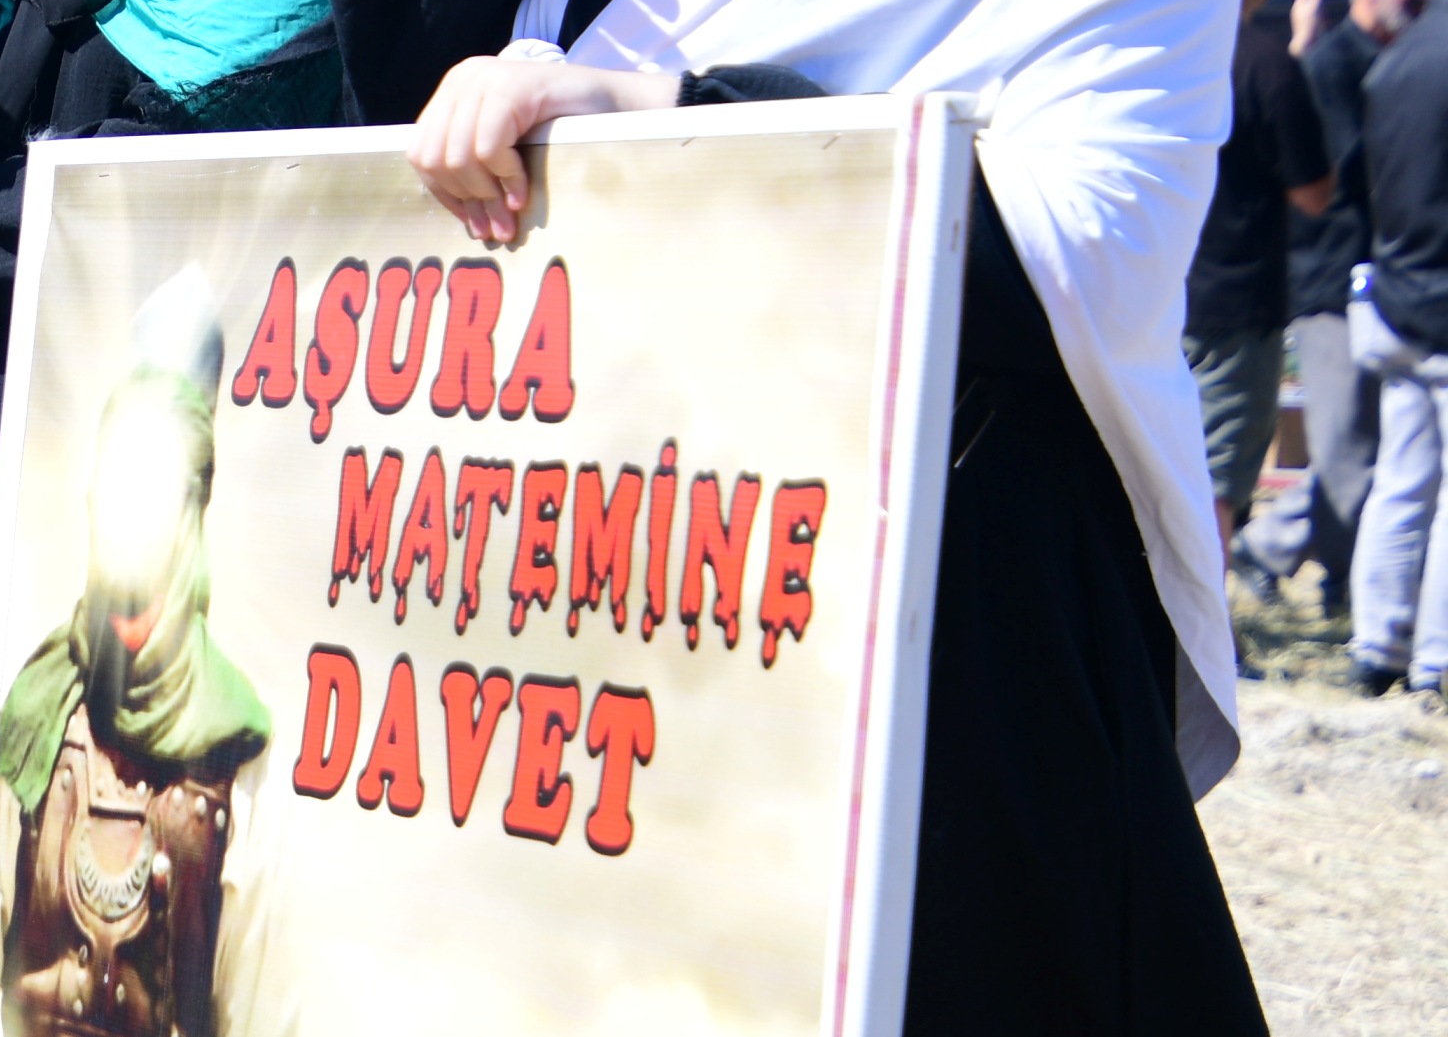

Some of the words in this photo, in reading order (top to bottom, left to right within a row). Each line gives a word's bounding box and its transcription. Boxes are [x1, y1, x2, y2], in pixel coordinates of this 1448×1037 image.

[232, 256, 575, 443] AŞURA
[327, 437, 827, 669] MATEMİNE
[293, 643, 655, 856] DAVET
